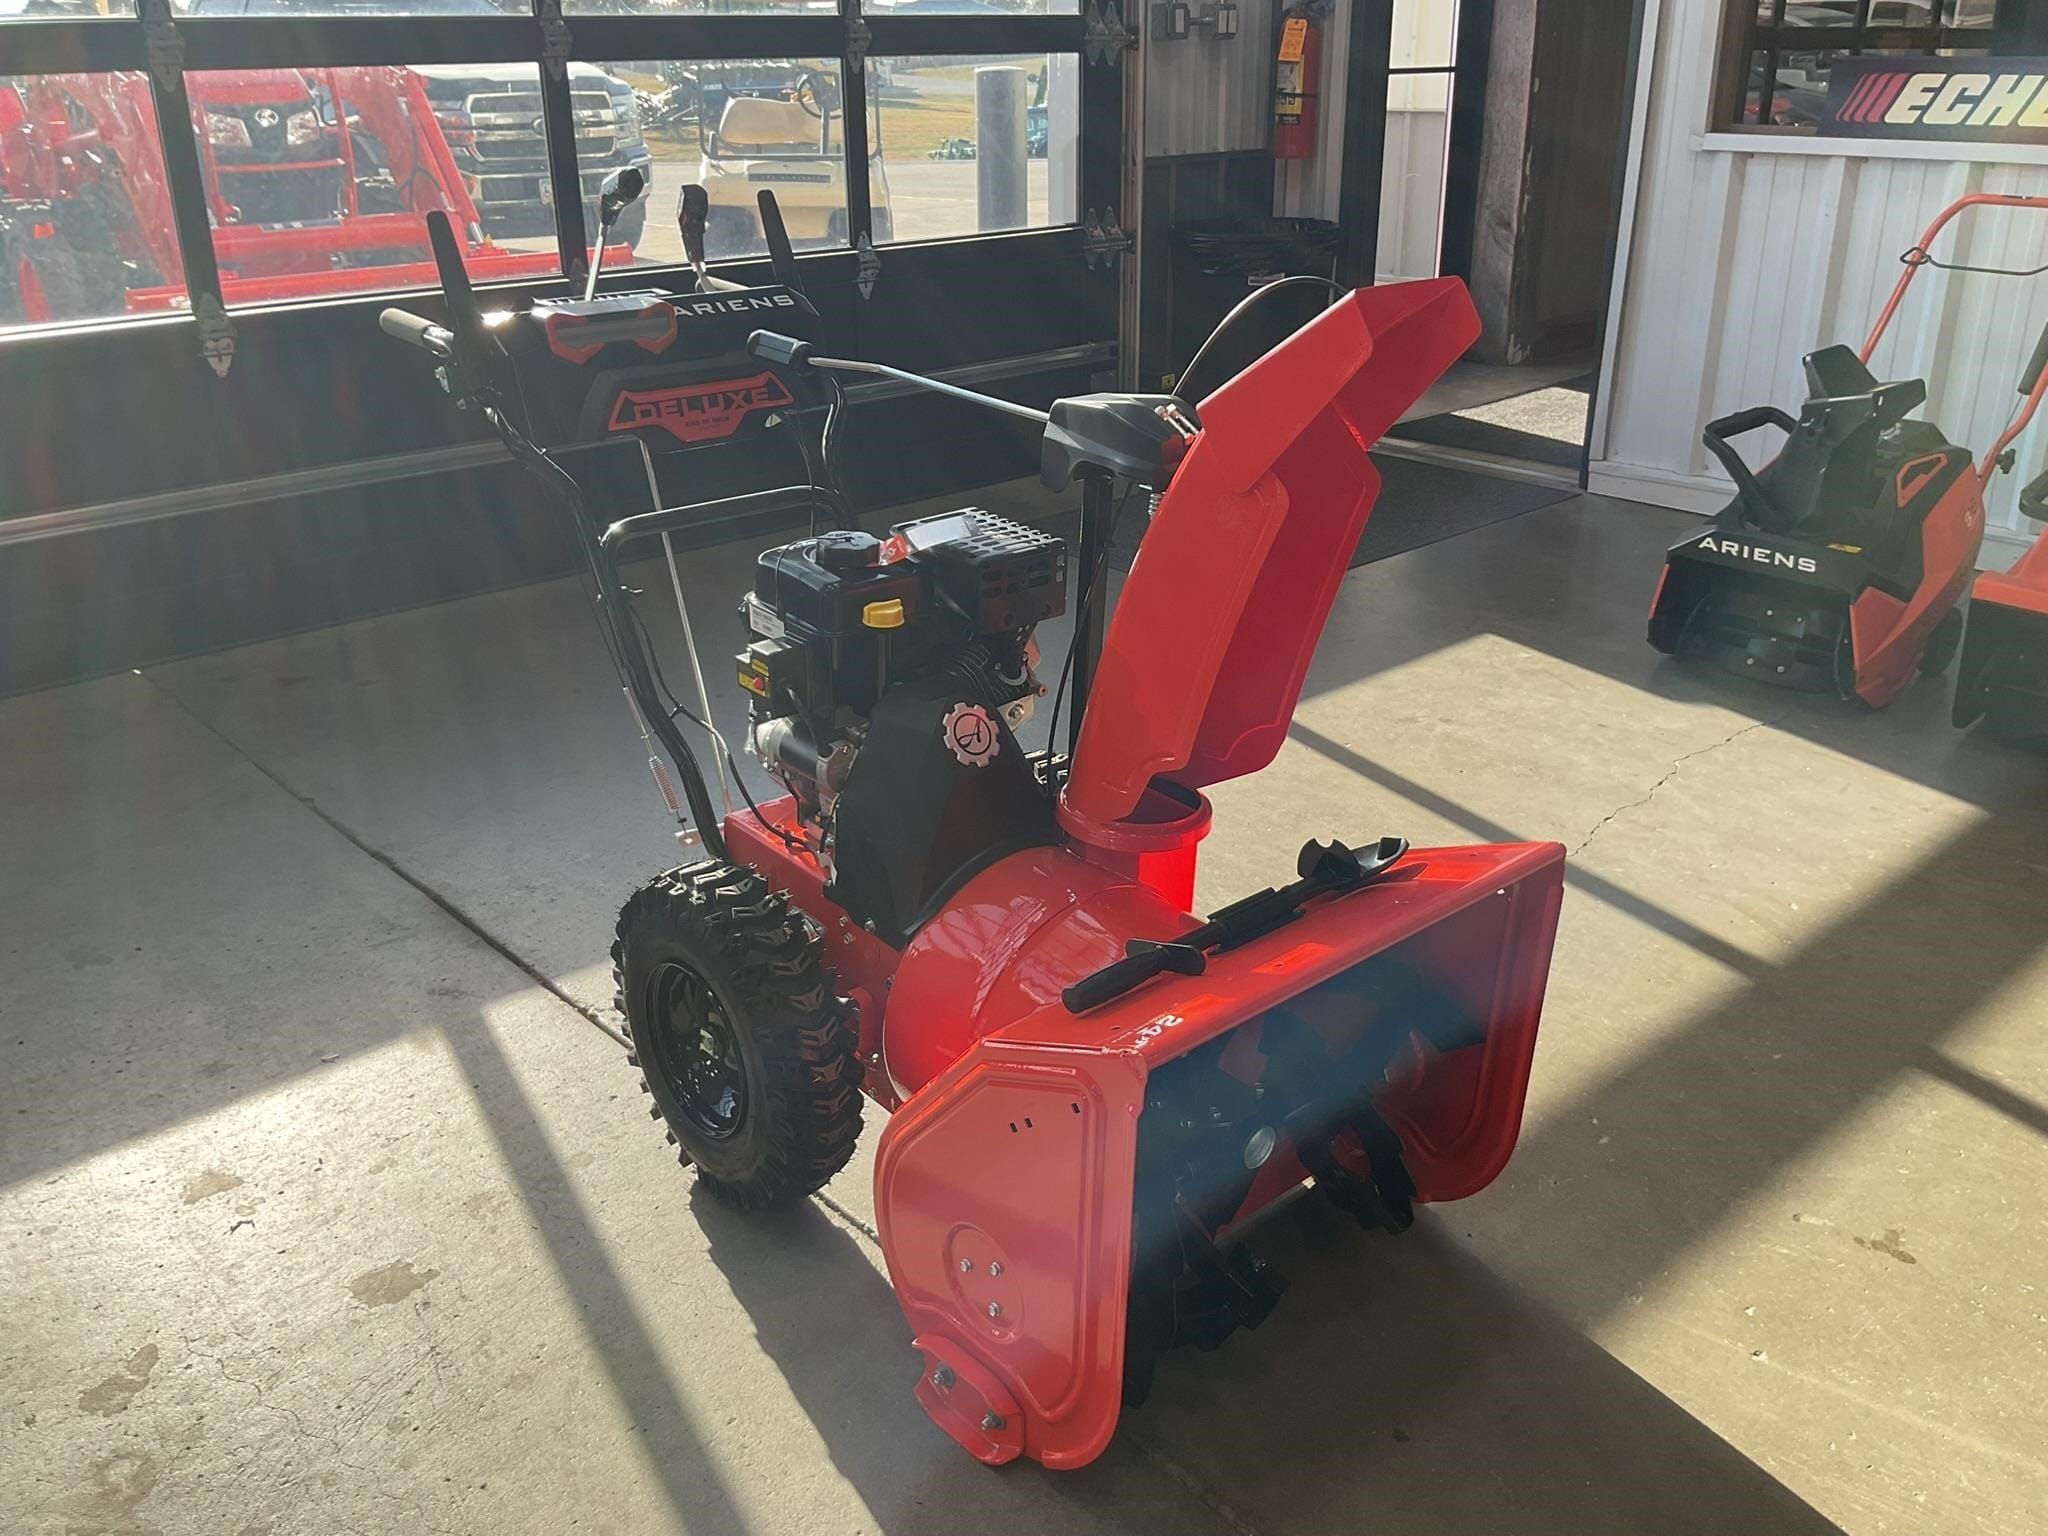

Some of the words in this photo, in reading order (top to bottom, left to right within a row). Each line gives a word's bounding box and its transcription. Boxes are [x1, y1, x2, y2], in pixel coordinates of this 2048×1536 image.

[675, 294, 795, 318] ARIENS
[633, 387, 770, 421] DELUXE
[1698, 537, 1817, 573] ARIENS
